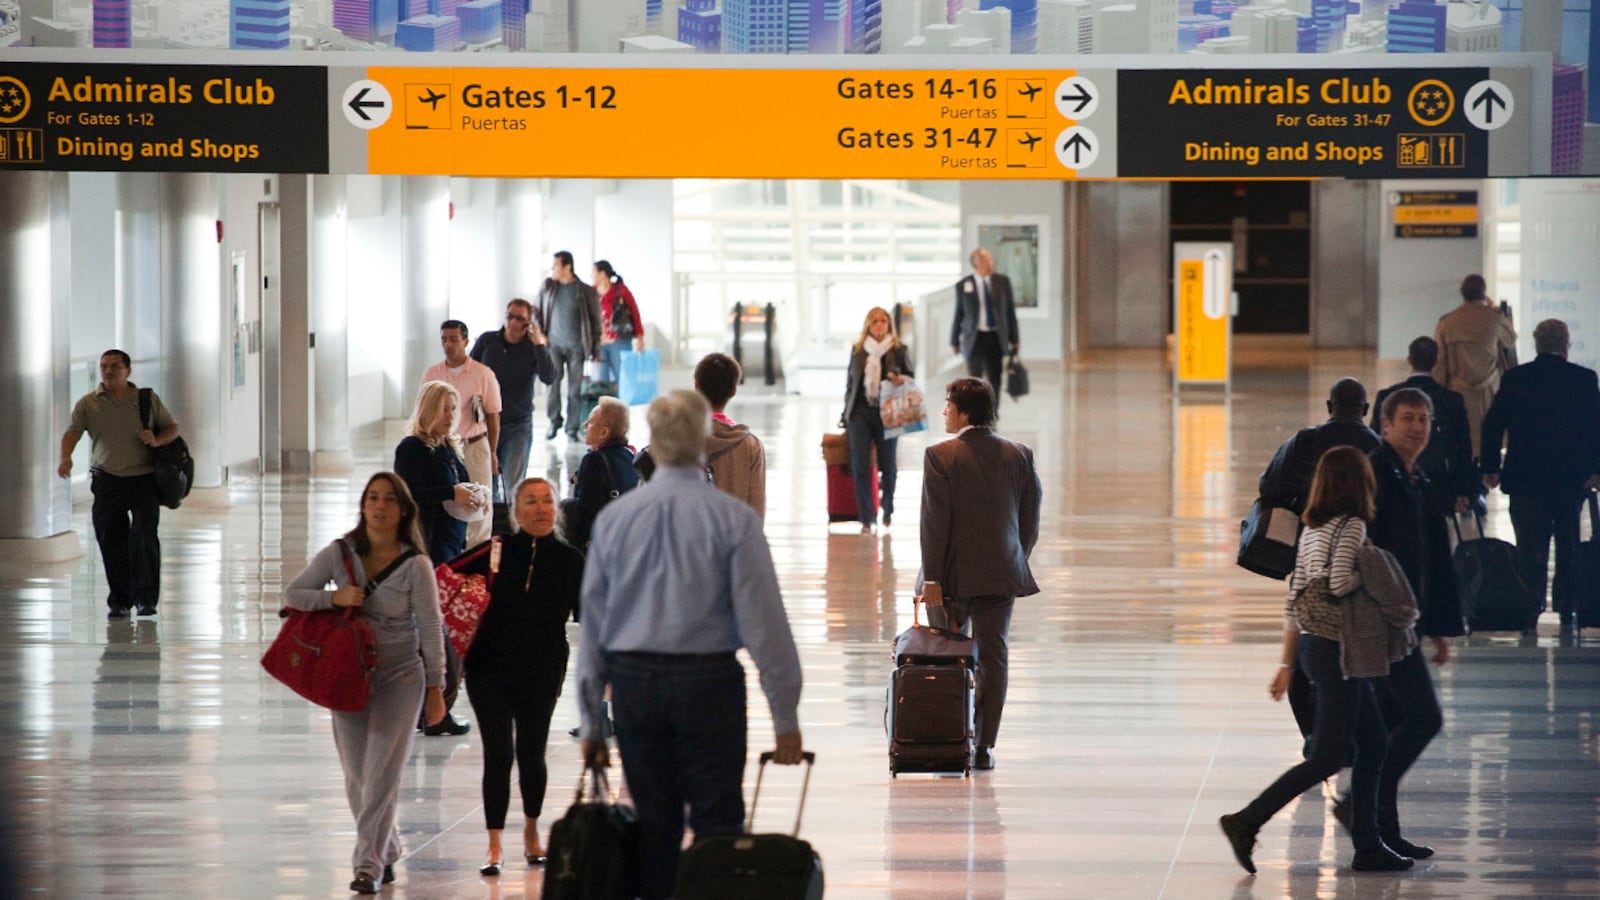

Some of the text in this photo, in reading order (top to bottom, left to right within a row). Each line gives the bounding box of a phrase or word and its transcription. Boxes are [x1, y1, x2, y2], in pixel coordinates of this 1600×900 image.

[48, 76, 275, 105] Admirals Club
[462, 84, 616, 108] Gates 1-12
[838, 78, 996, 99] Gates 14-16
[1169, 78, 1391, 104] Admirals Club
[48, 112, 154, 126] For Gates 1-12
[941, 106, 997, 119] Puertas
[1276, 114, 1391, 126] For Gates 31-47
[462, 116, 526, 130] Puertas
[838, 128, 997, 148] Gates 31-47
[58, 137, 259, 162] Dining and Shops
[1186, 142, 1383, 165] Dining and Shops
[941, 156, 997, 168] Puertas
